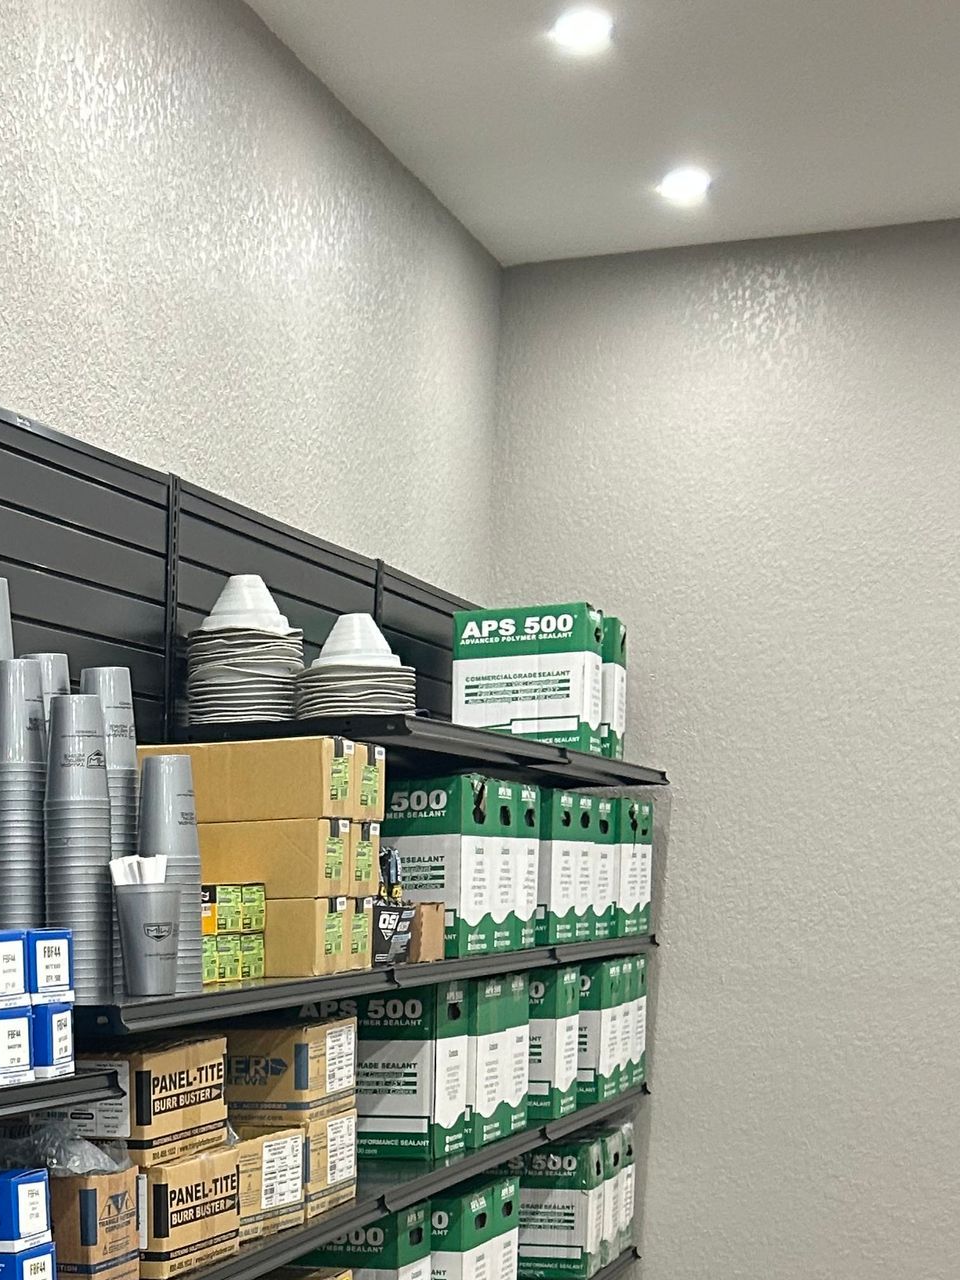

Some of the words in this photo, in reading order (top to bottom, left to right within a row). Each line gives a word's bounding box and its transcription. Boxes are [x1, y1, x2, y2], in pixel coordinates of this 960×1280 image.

[462, 619, 515, 639] APS
[524, 614, 573, 633] 500
[460, 637, 499, 645] ADVANCED
[501, 634, 536, 642] POLYMER
[539, 631, 573, 639] SEALANT
[390, 790, 448, 811] 500
[407, 810, 447, 818] SEALANT
[368, 999, 422, 1019] 500
[152, 1062, 223, 1095] PANEL-TITE
[154, 1097, 177, 1112] BURR
[179, 1088, 210, 1106] BUSTER
[532, 1155, 577, 1170] 500
[170, 1173, 236, 1208] PANEL-TITE
[172, 1209, 194, 1225] BURR
[196, 1199, 225, 1218] BUSTER
